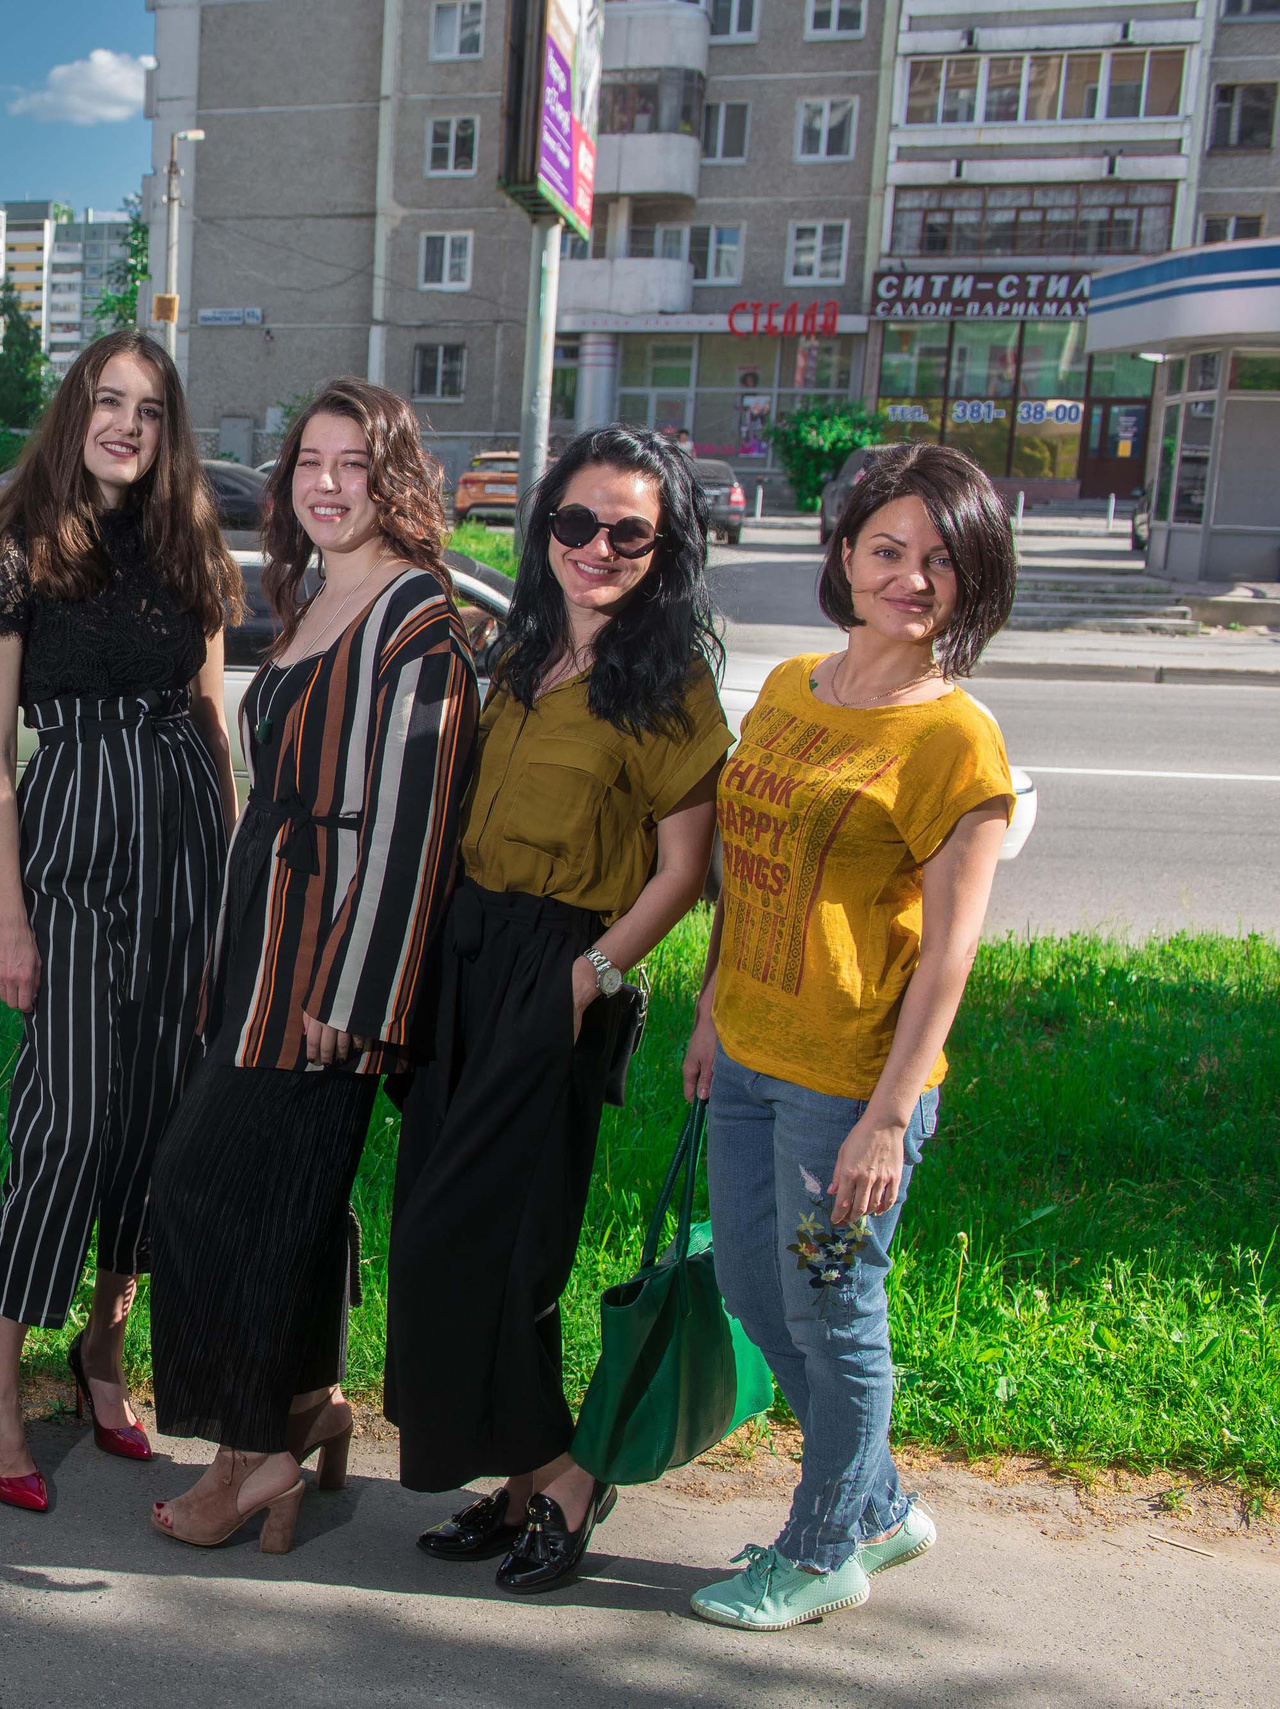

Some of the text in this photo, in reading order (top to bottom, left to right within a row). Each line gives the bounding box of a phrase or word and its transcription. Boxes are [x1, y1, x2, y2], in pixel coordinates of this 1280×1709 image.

[728, 299, 839, 337] СТЕЛЛА
[952, 401, 1006, 423] 381-
[1017, 401, 1081, 424] 38-00
[719, 757, 804, 809] THINK
